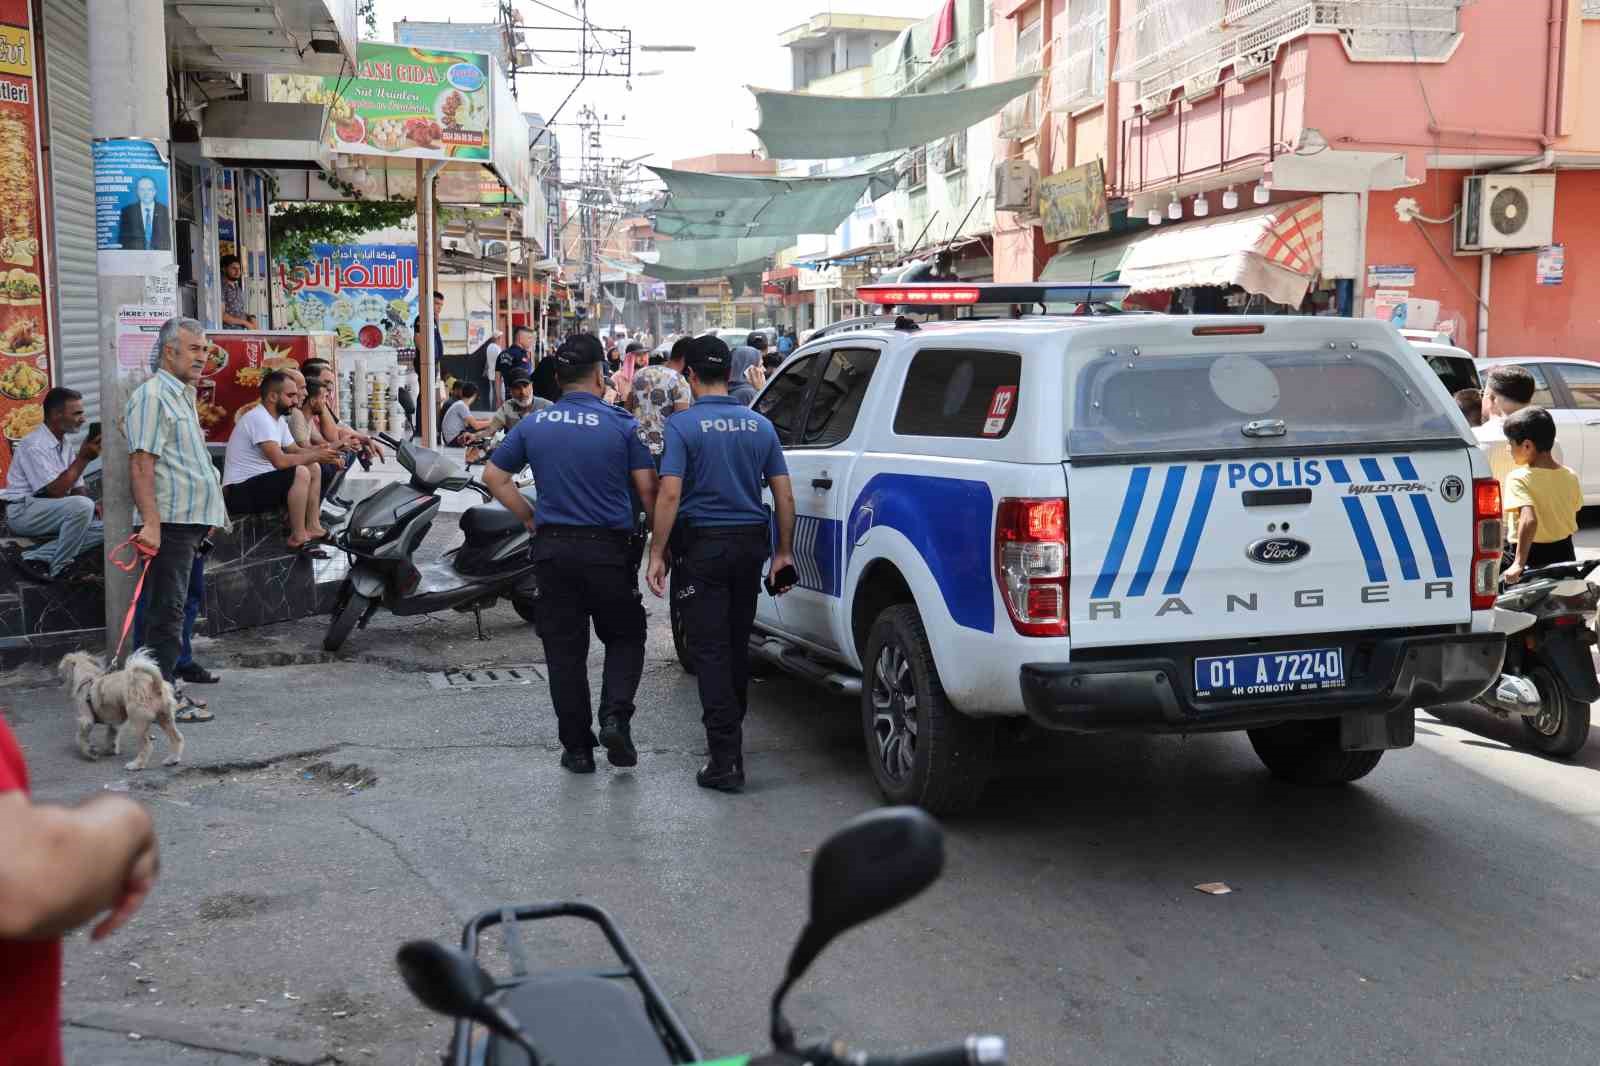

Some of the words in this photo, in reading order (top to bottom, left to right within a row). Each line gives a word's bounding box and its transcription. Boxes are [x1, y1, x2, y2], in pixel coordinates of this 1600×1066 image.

[992, 391, 1011, 415] 112
[1262, 541, 1298, 559] Ford
[1089, 581, 1454, 620] RANGER
[1210, 660, 1235, 687] 01
[1255, 657, 1268, 684] A
[1274, 651, 1339, 682] 72240
